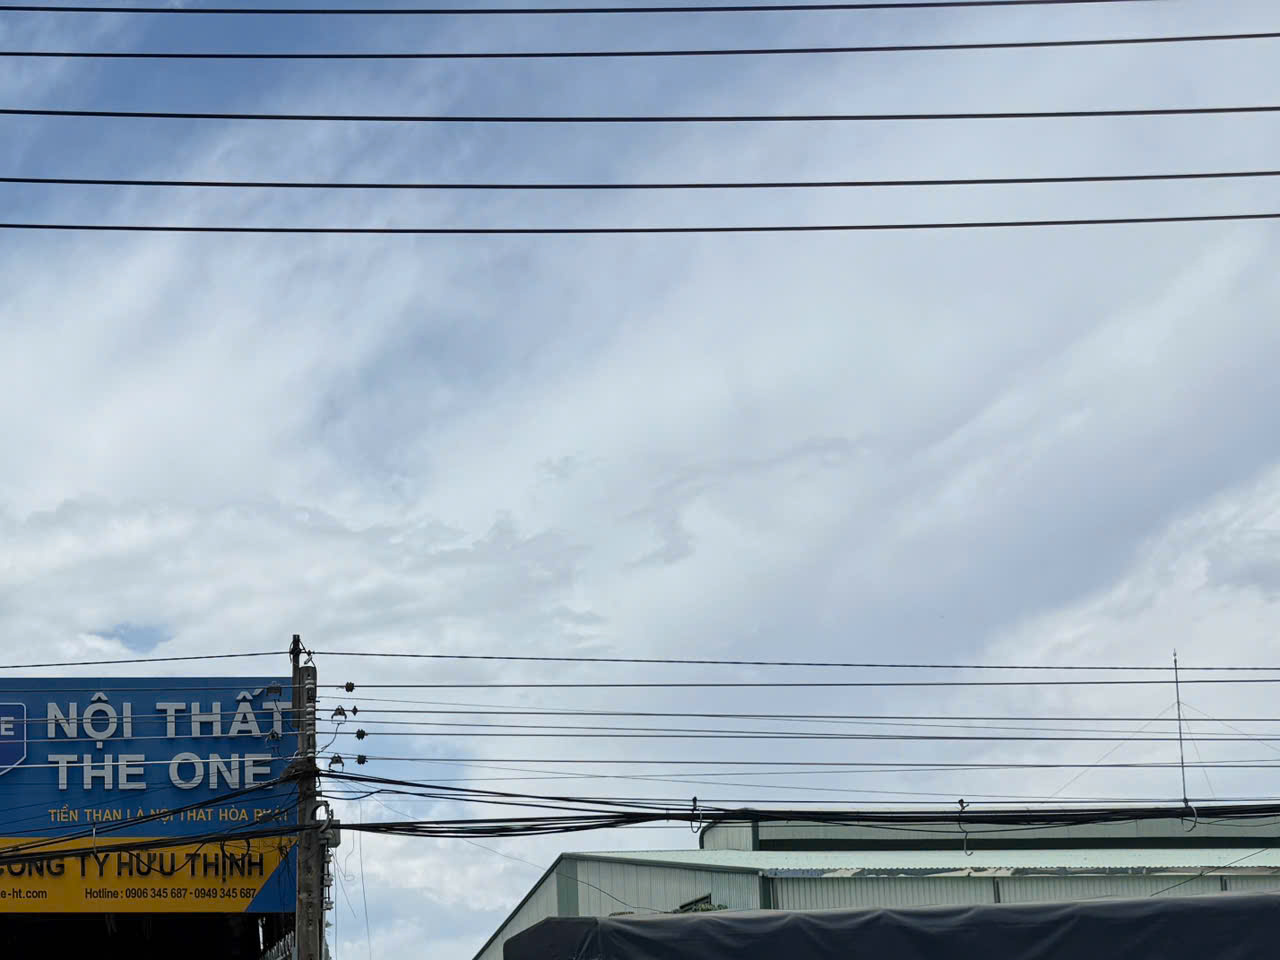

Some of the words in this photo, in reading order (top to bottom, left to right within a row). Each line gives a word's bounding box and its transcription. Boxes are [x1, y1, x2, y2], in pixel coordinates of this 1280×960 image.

[47, 692, 132, 749] NỘI
[156, 688, 292, 738] THẤT
[48, 753, 146, 790] THE
[169, 752, 273, 790] ONE
[220, 805, 248, 821] HÒA
[78, 853, 110, 877] TY
[185, 853, 264, 883] THỊNH
[125, 888, 148, 899] 0906
[150, 888, 168, 899] 345
[170, 888, 188, 899] 687
[194, 888, 217, 899] 0949
[220, 888, 238, 899] 345
[240, 888, 257, 899] 687
